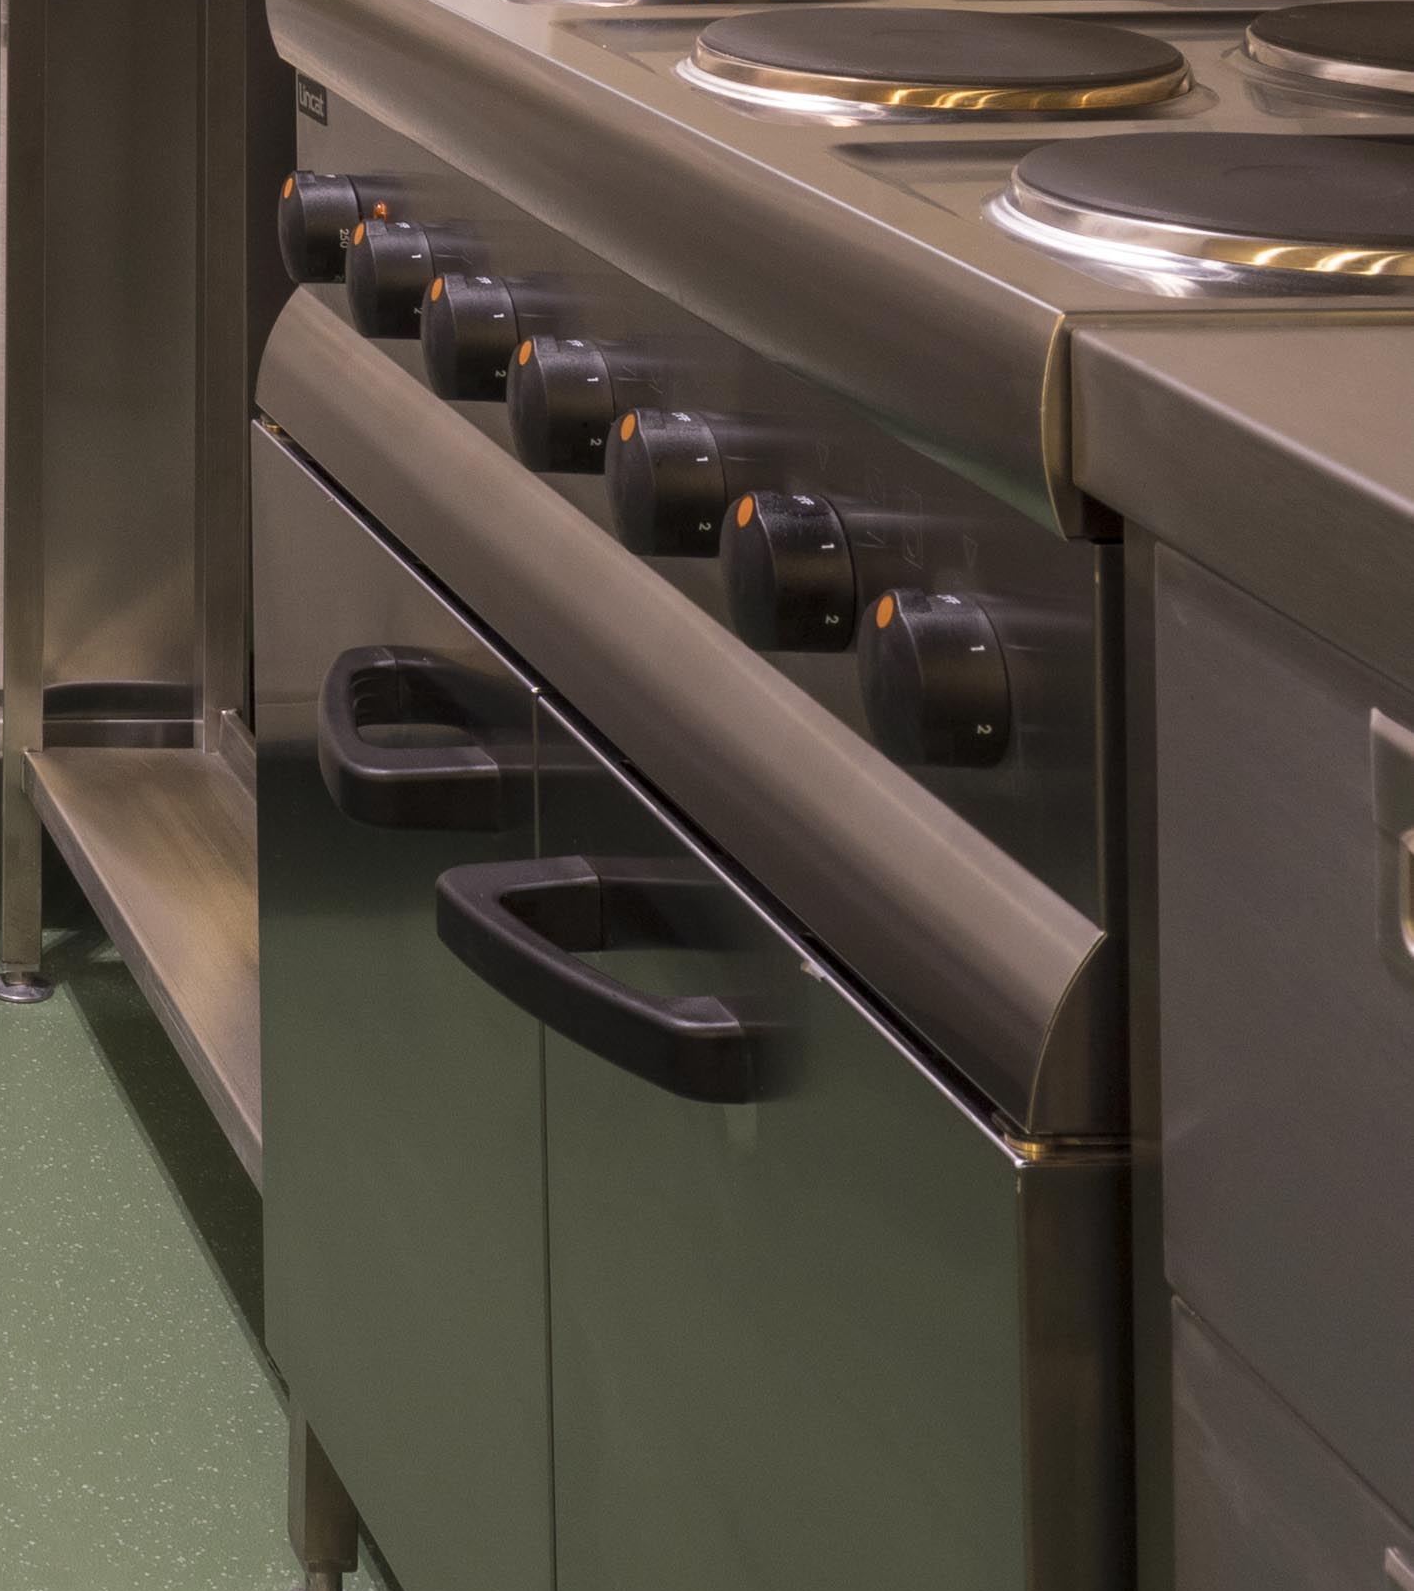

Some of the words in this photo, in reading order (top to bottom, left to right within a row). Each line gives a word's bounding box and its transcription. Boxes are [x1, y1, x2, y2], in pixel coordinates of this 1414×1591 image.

[339, 228, 350, 249] 250
[494, 369, 507, 378] 2
[590, 438, 603, 446] 2
[698, 522, 712, 531] 2
[825, 614, 840, 625] 2
[976, 724, 992, 735] 2
